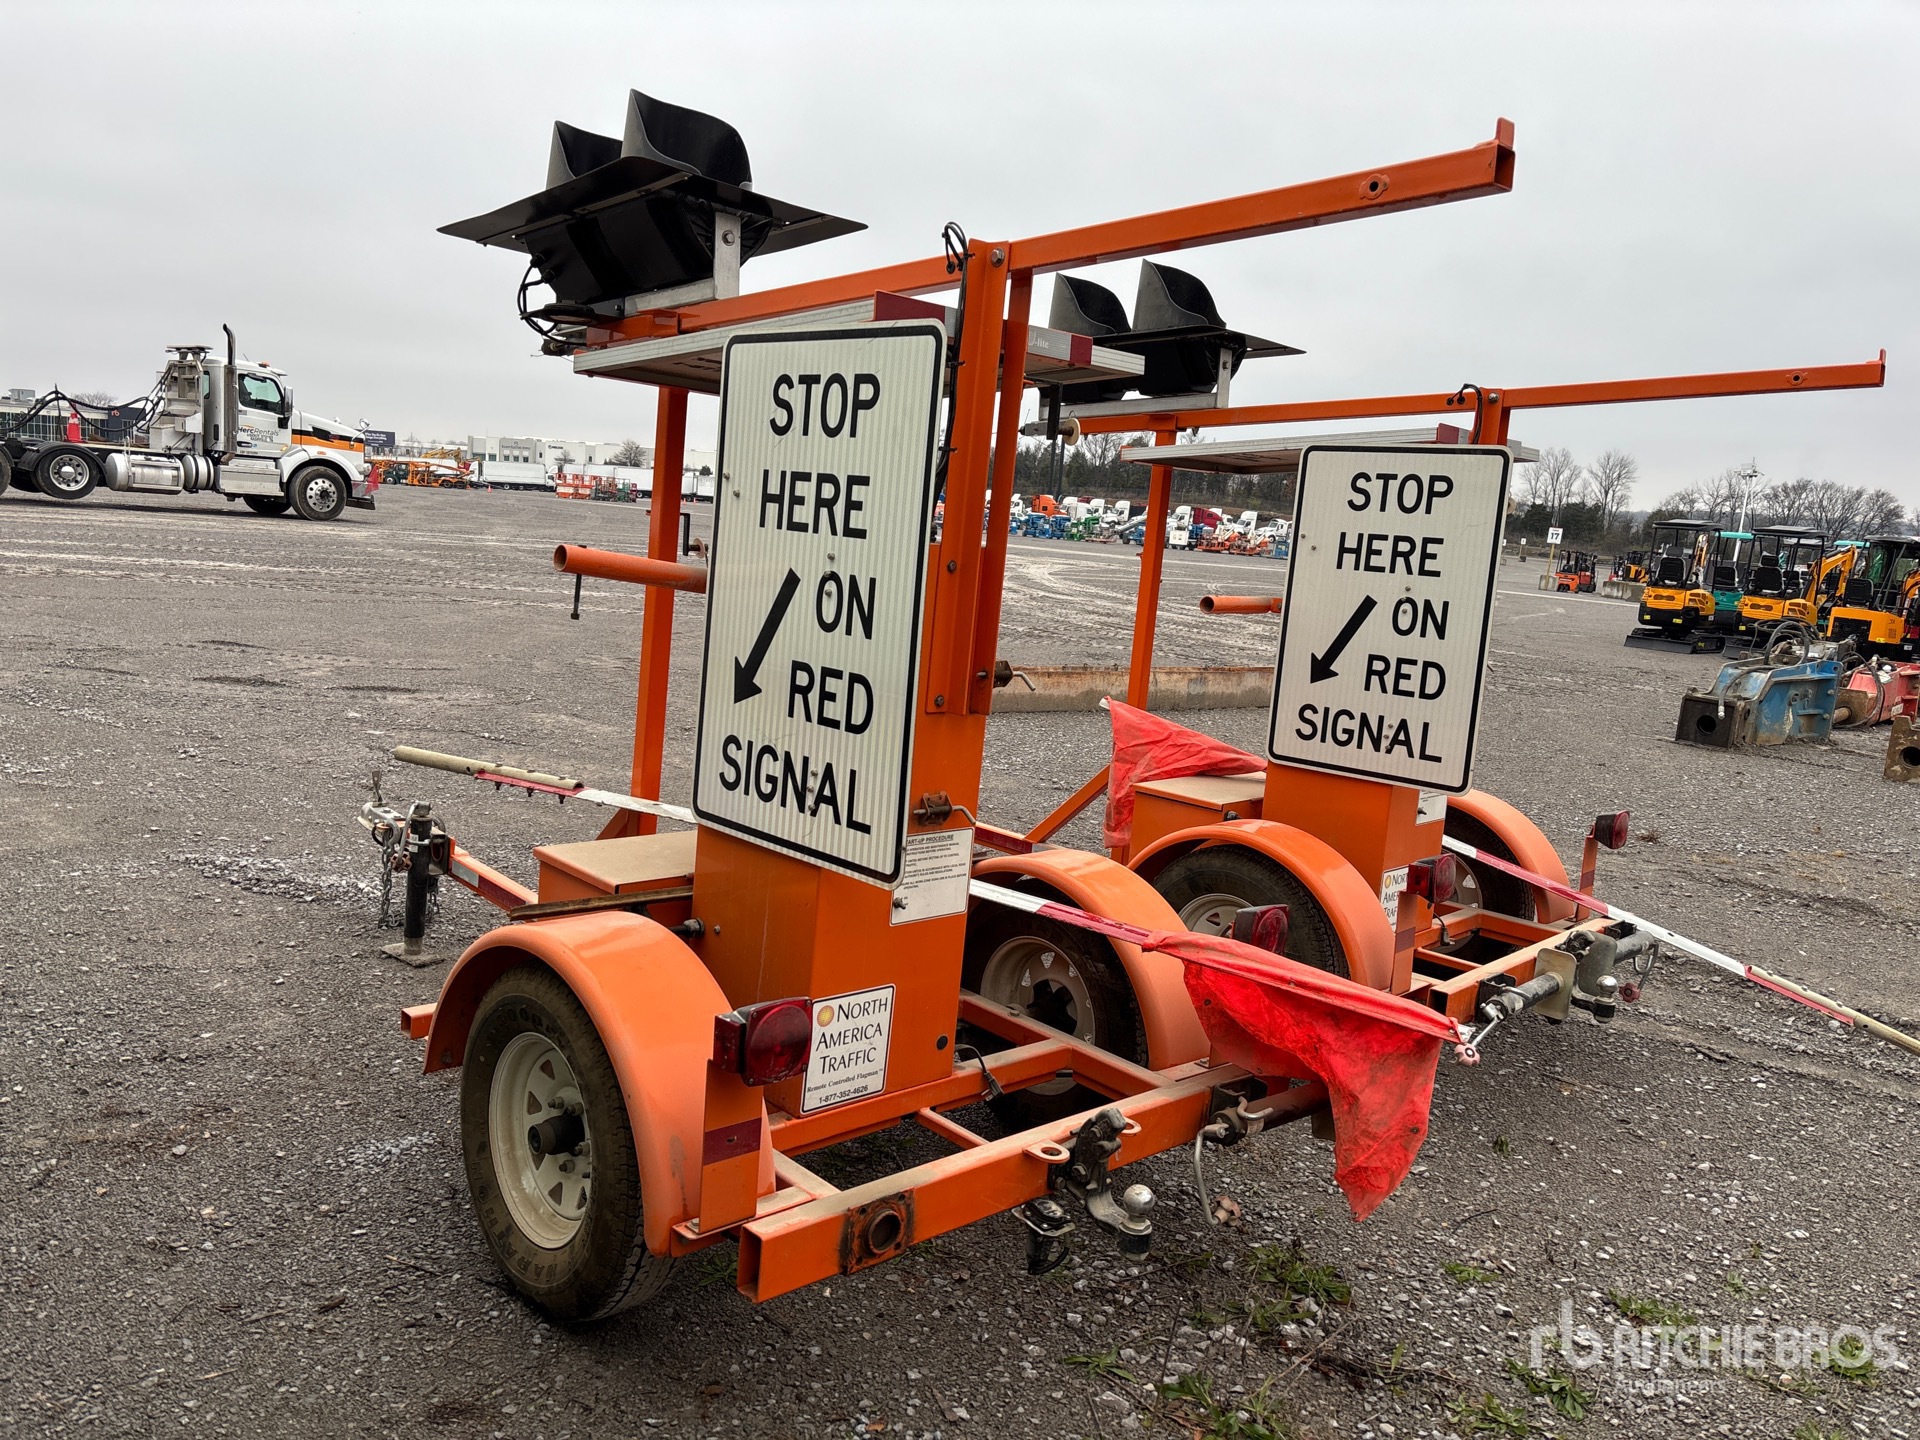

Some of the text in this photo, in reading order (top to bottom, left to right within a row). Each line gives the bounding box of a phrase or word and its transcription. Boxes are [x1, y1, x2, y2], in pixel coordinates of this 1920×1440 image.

[769, 372, 881, 439] STOP
[758, 468, 870, 540] HERE
[1347, 472, 1453, 515] STOP
[1336, 531, 1444, 577] HERE
[1550, 532, 1560, 540] 17
[816, 570, 876, 641] ON
[1392, 596, 1449, 640] ON
[788, 659, 873, 735] RED
[1364, 653, 1446, 700] RED
[1295, 703, 1442, 763] SIGNAL
[719, 734, 872, 835] SIGNAL
[837, 997, 888, 1022] NORTH
[815, 1022, 883, 1052] AMERICA
[807, 1083, 827, 1093] Remote
[828, 1074, 856, 1087] Controlled
[819, 1047, 877, 1075] TRAFFIC
[819, 1084, 869, 1104] 1-877-352-4626
